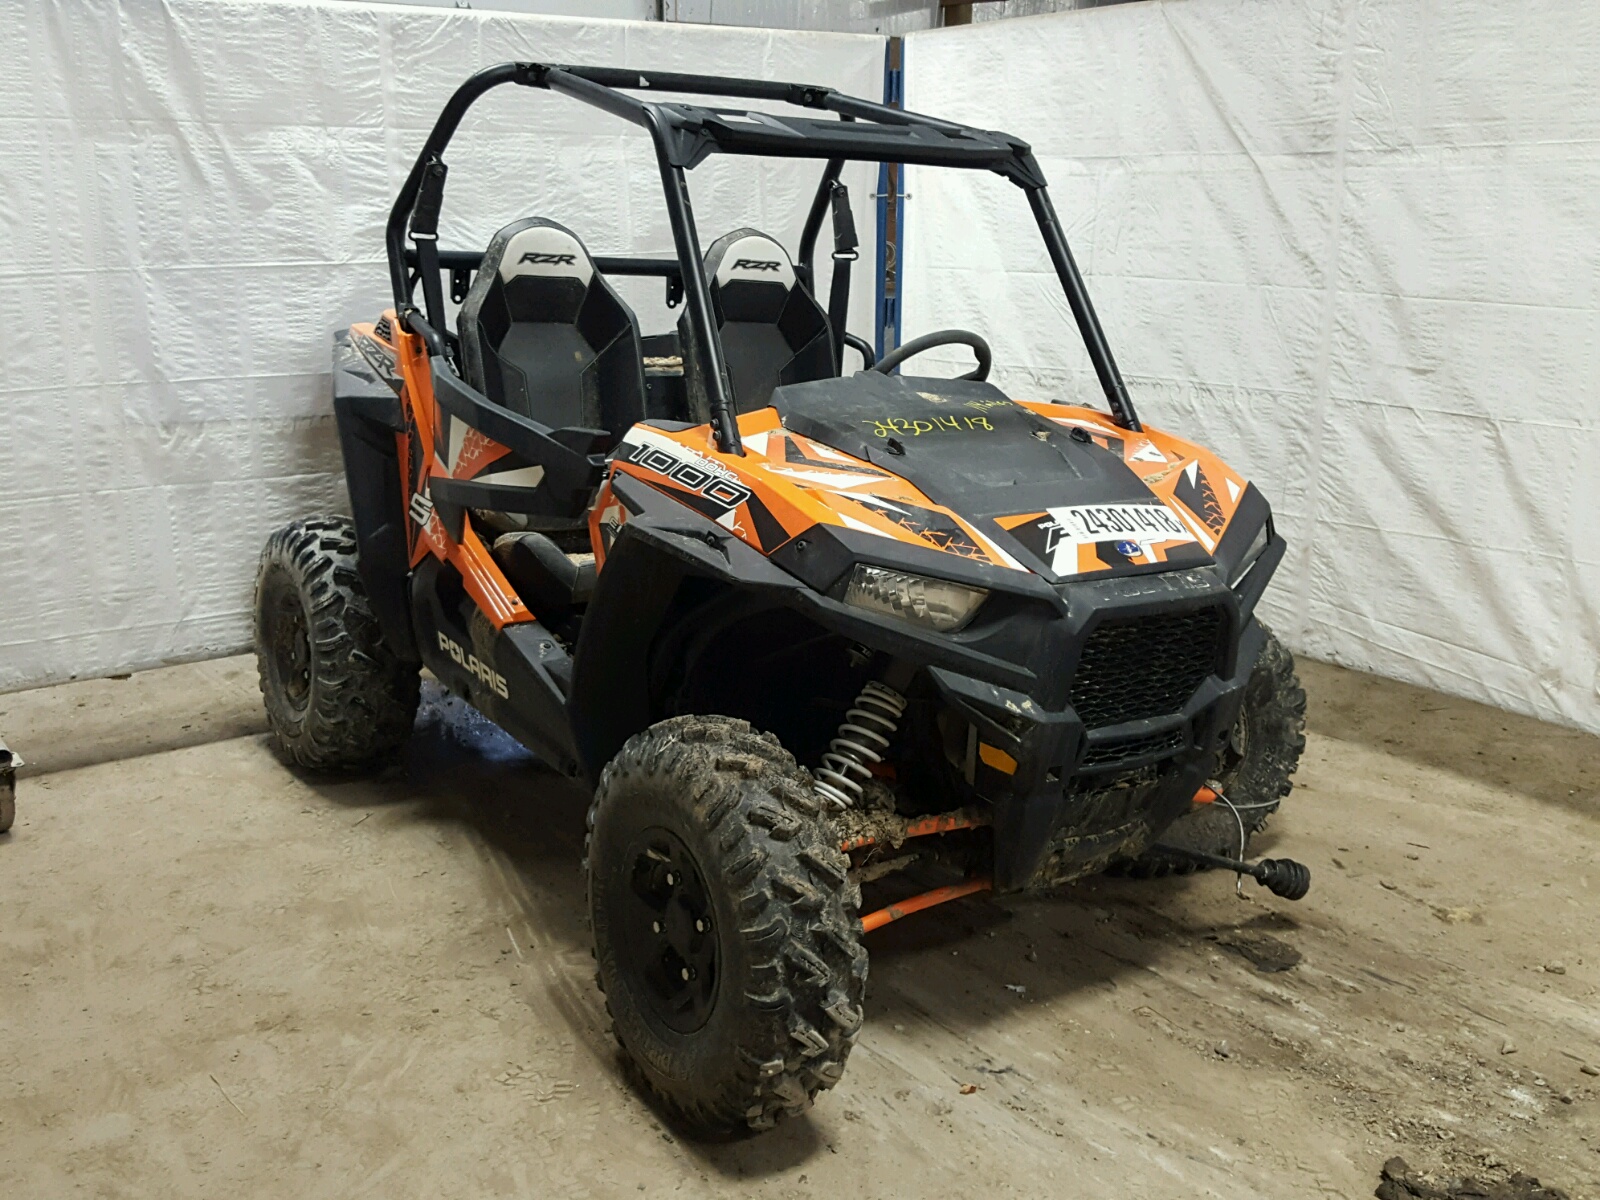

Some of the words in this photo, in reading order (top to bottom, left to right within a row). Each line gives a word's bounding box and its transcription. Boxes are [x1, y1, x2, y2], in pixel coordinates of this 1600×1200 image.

[517, 252, 577, 266] RZR
[731, 258, 782, 272] RZR
[629, 441, 752, 509] 1000
[1071, 508, 1182, 534] 24301418
[437, 630, 510, 700] POLARIS
